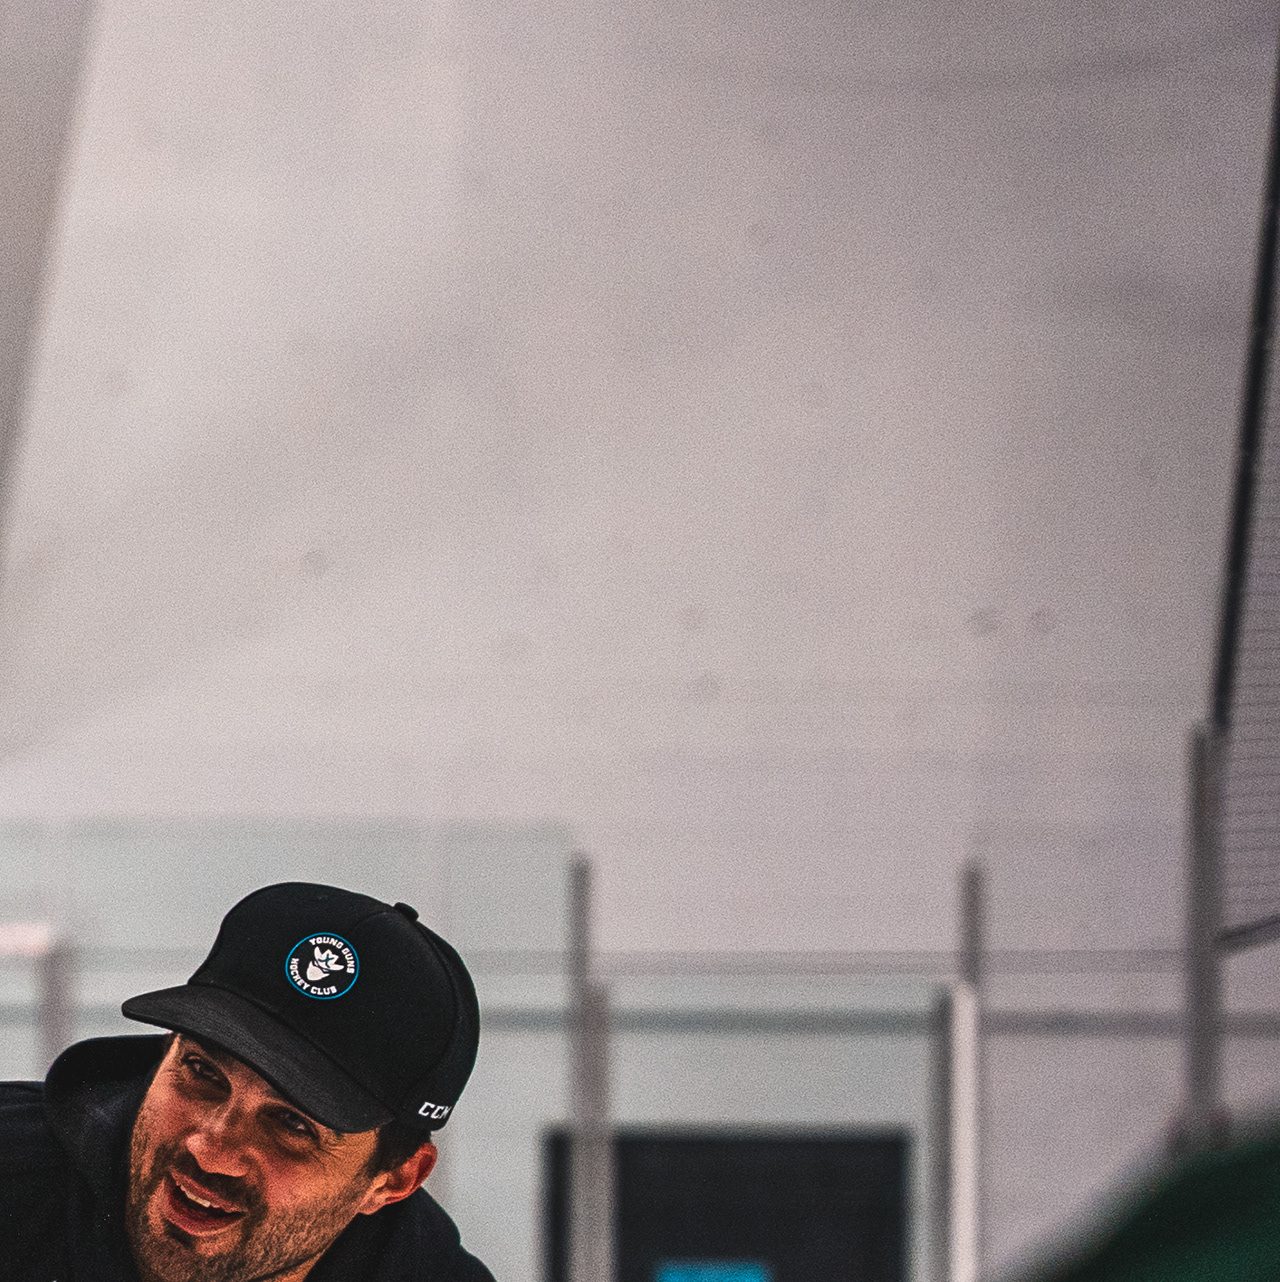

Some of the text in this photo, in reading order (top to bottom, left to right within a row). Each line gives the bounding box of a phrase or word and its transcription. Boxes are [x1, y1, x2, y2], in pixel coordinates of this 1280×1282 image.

[309, 936, 355, 974] YOUNG GUNS
[290, 957, 337, 995] HOCKEY CLUB
